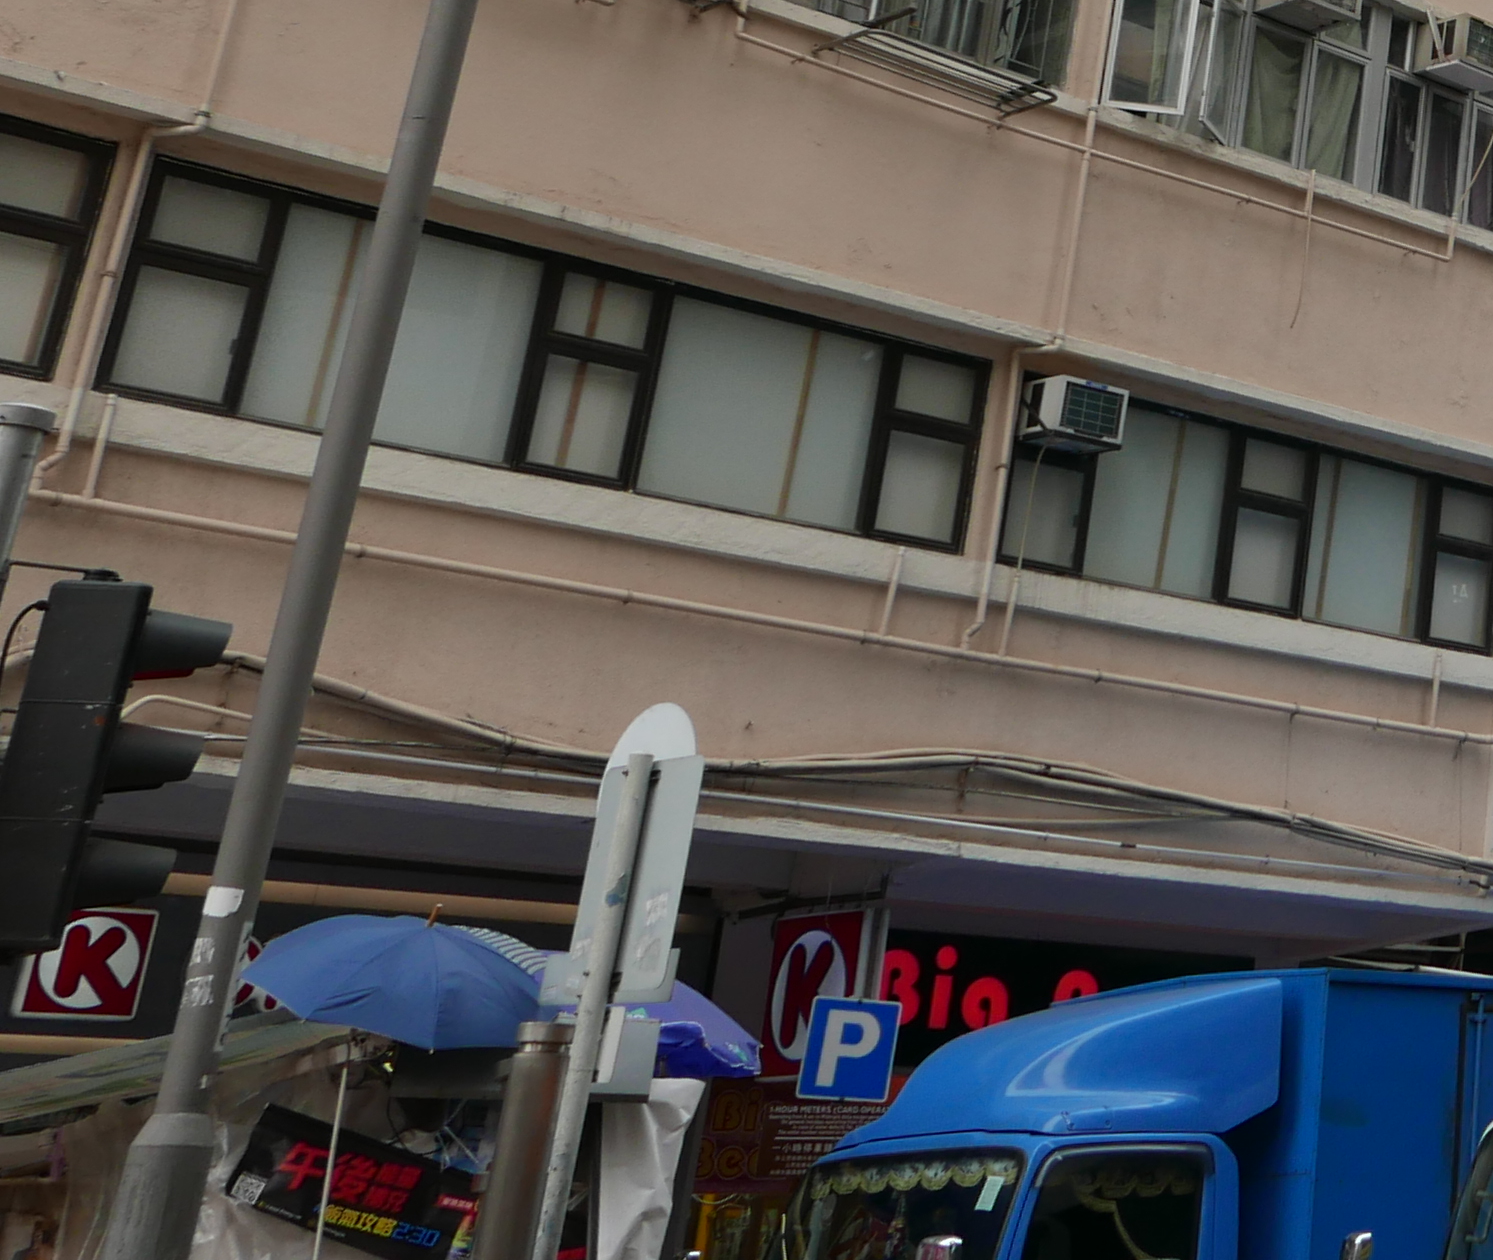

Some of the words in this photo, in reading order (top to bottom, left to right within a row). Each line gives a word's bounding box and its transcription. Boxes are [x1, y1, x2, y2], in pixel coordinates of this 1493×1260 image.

[815, 1009, 881, 1087] P
[799, 1105, 832, 1114] METERS
[390, 1221, 442, 1248] 2:30
